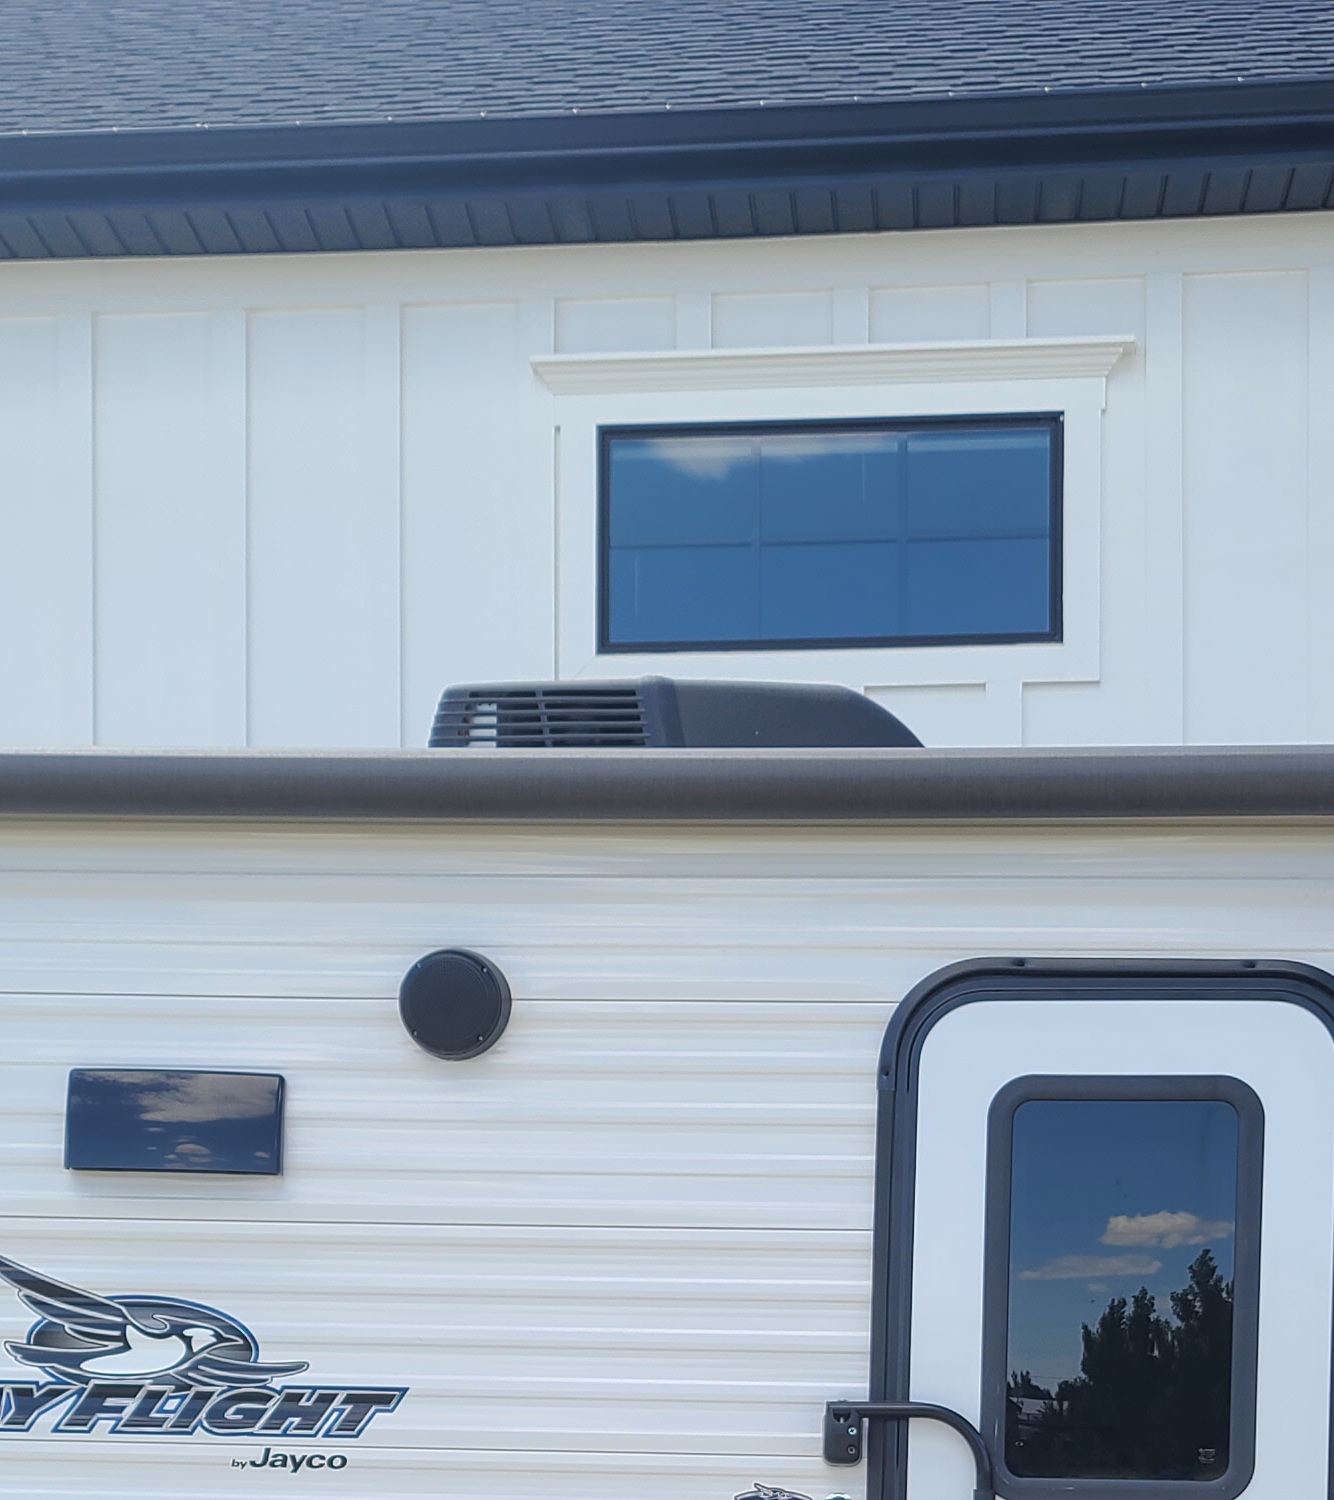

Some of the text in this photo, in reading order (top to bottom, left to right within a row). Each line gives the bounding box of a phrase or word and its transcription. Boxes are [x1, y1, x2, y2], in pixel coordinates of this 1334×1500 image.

[51, 1379, 410, 1438] FLIGHT
[231, 1447, 348, 1473] by Jayco
